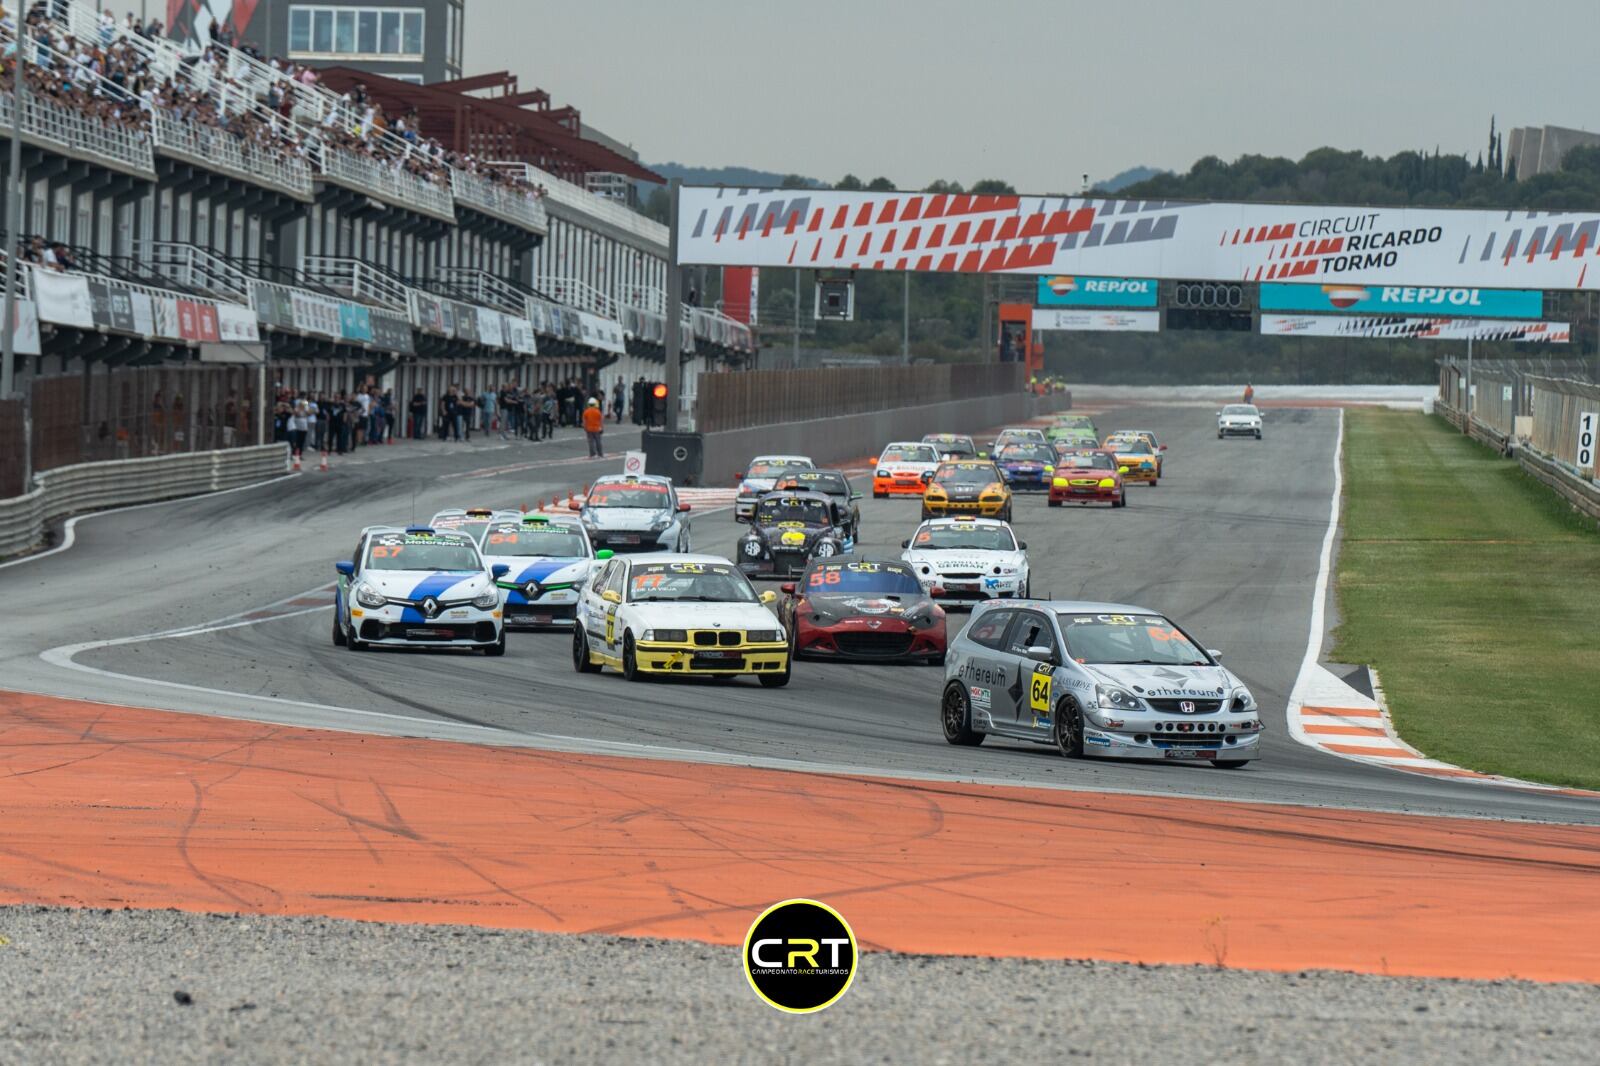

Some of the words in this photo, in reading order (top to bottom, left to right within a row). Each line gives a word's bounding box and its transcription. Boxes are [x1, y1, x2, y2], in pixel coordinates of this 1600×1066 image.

[1299, 213, 1380, 239] CIRCUIT
[1347, 226, 1443, 252] RICARDO
[1322, 251, 1398, 274] TORMO
[1085, 280, 1149, 293] REPSOL
[1382, 286, 1481, 306] REPSOL
[1580, 415, 1592, 464] 100
[490, 533, 517, 544] 54
[373, 546, 402, 558] 57
[847, 562, 881, 570] CRT
[633, 575, 663, 588] 77
[809, 571, 841, 587] 58
[1097, 614, 1136, 622] CRT
[958, 657, 1006, 687] ethereum
[1038, 663, 1052, 673] CRT
[1032, 679, 1049, 704] 64
[1148, 686, 1218, 698] ethereum
